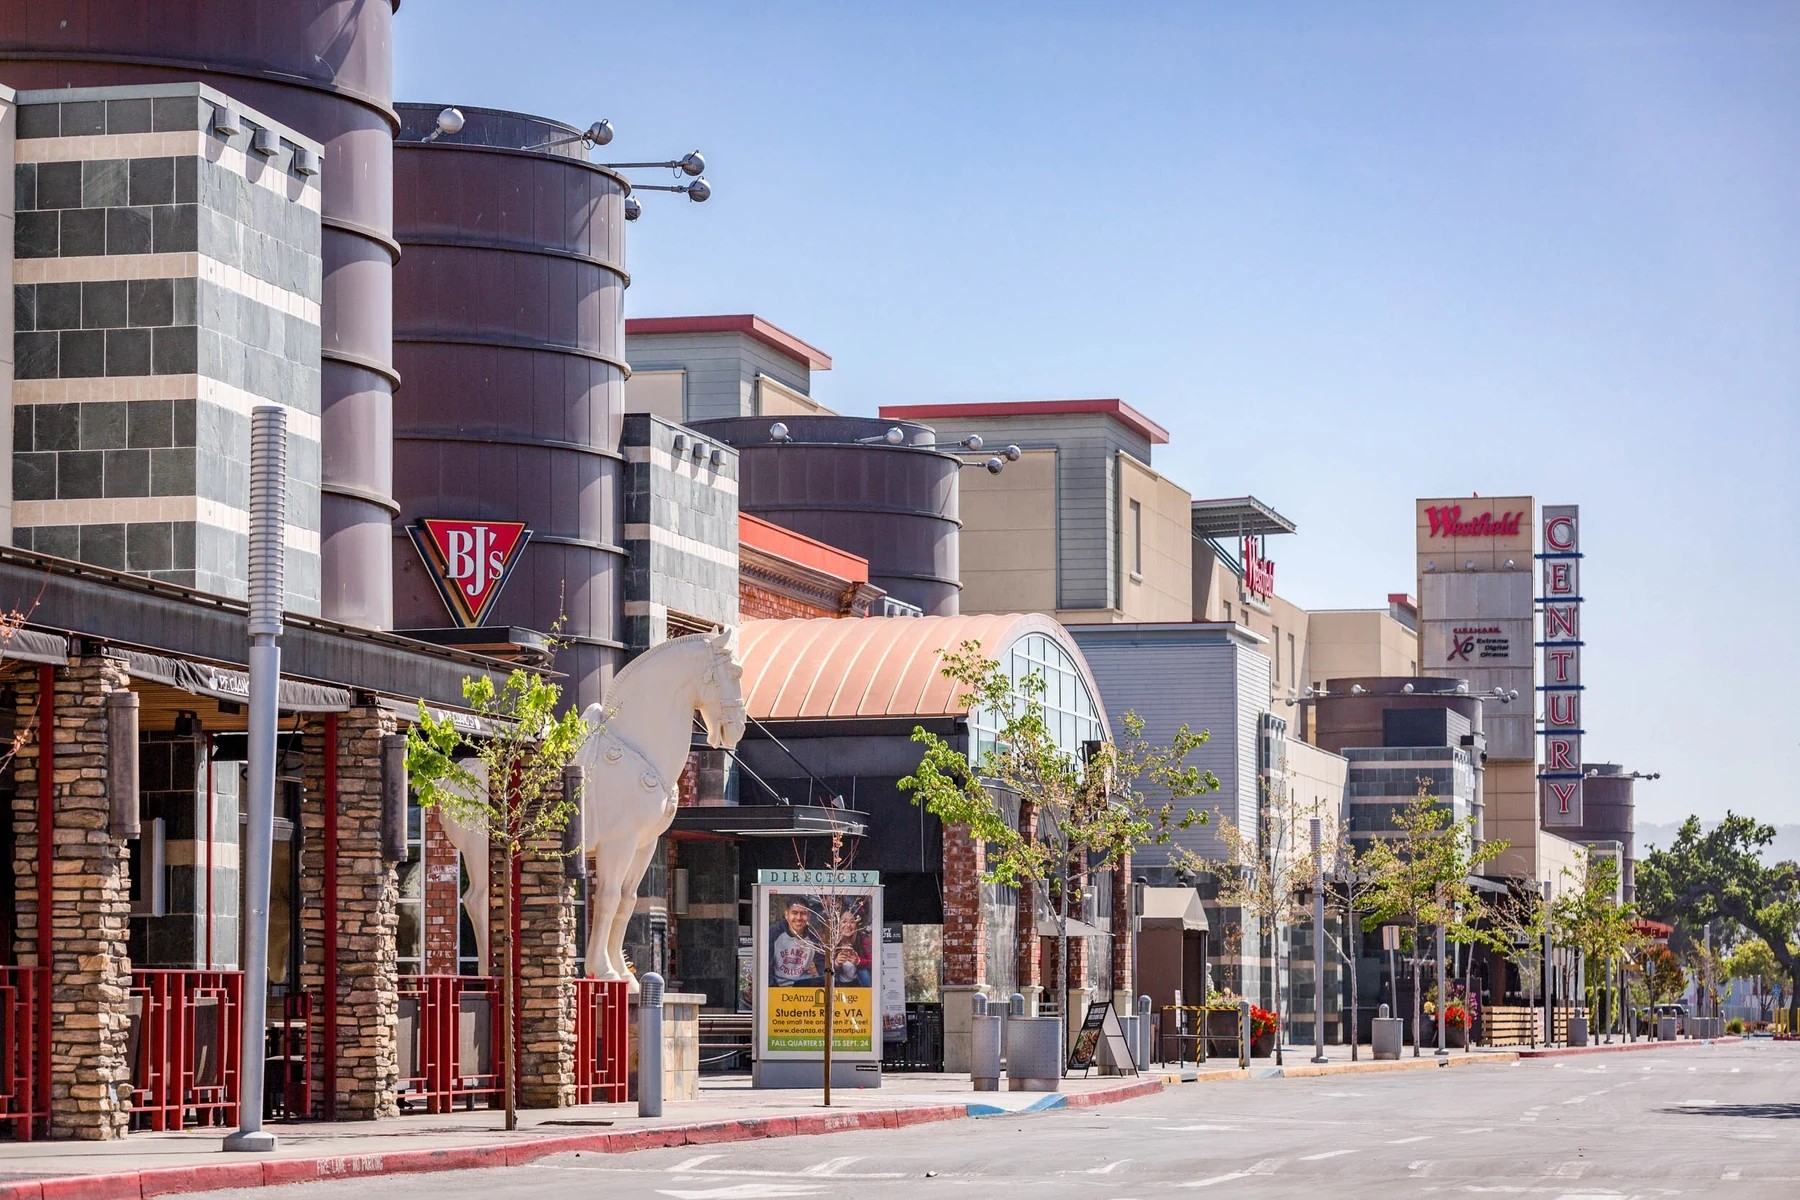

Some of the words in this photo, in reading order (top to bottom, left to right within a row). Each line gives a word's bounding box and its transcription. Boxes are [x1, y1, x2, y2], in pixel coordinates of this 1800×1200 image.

[1424, 505, 1524, 538] Westfield
[1545, 516, 1577, 813] CENTURY
[771, 871, 869, 883] DIRECTORY
[780, 964, 806, 976] COLLEGE
[781, 993, 814, 1002] DeAnza
[775, 1008, 816, 1017] Students
[819, 1009, 840, 1017] Re
[844, 1009, 863, 1017] VTA
